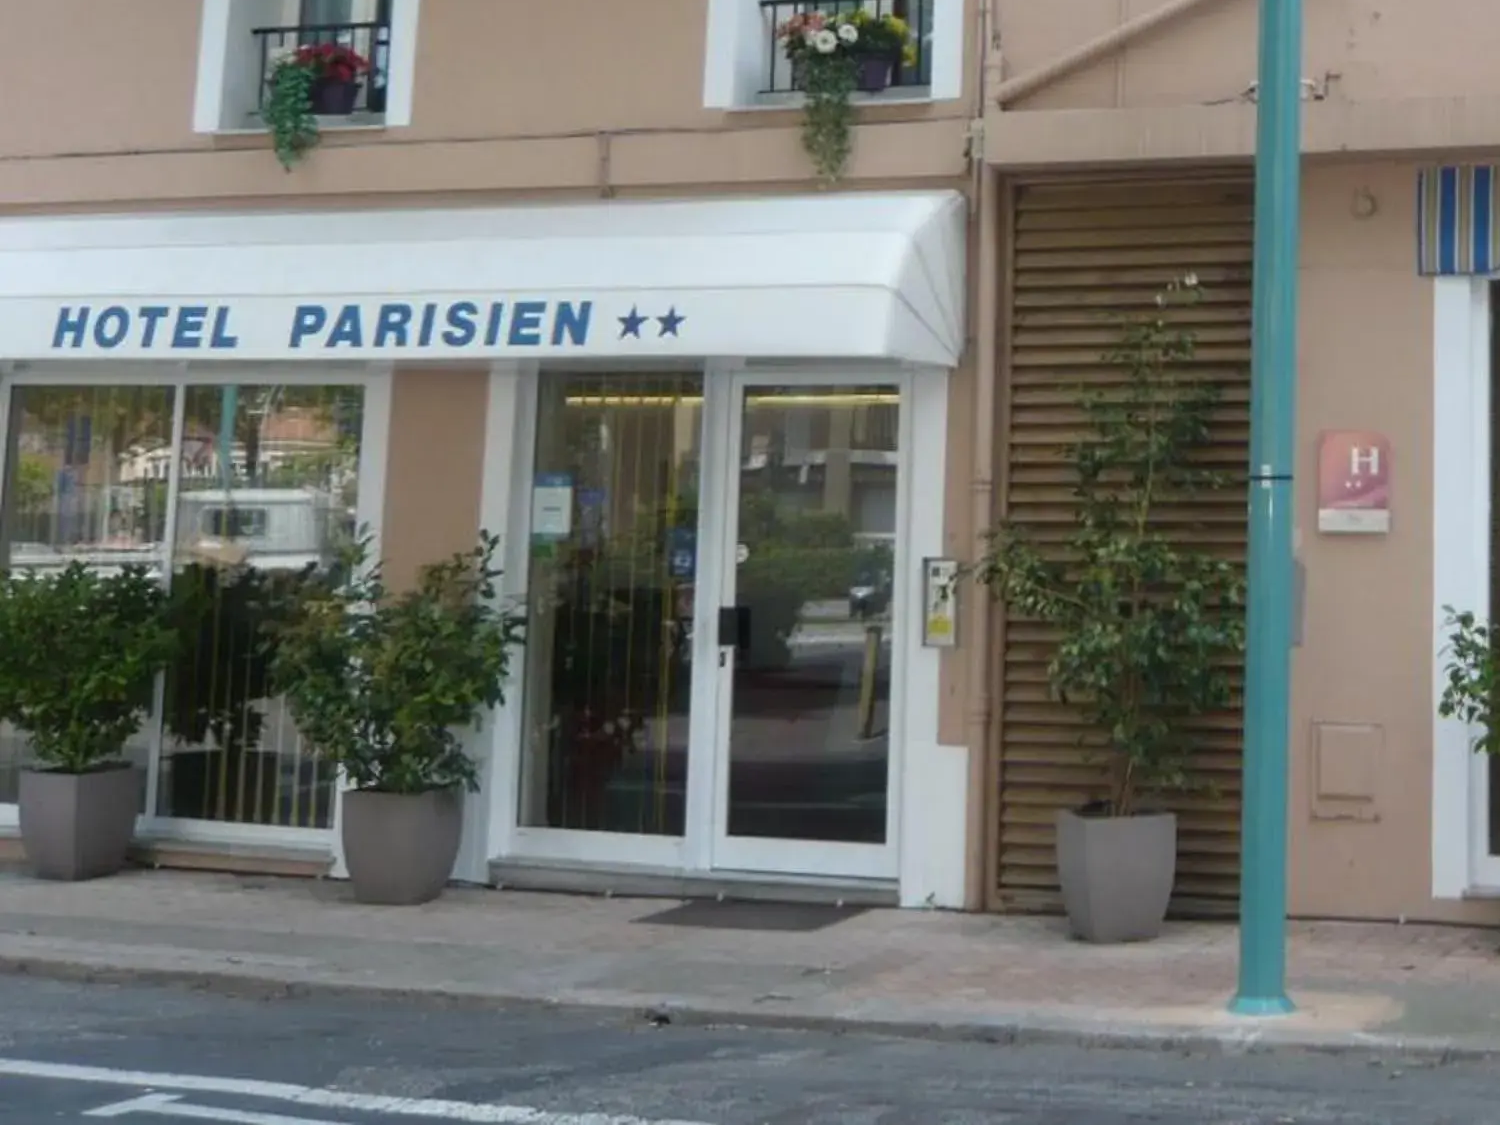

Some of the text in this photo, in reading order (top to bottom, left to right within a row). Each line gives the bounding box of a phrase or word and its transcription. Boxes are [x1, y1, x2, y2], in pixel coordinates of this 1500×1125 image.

[51, 301, 593, 349] HOTEL PARISIEN
[1351, 446, 1379, 475] H
